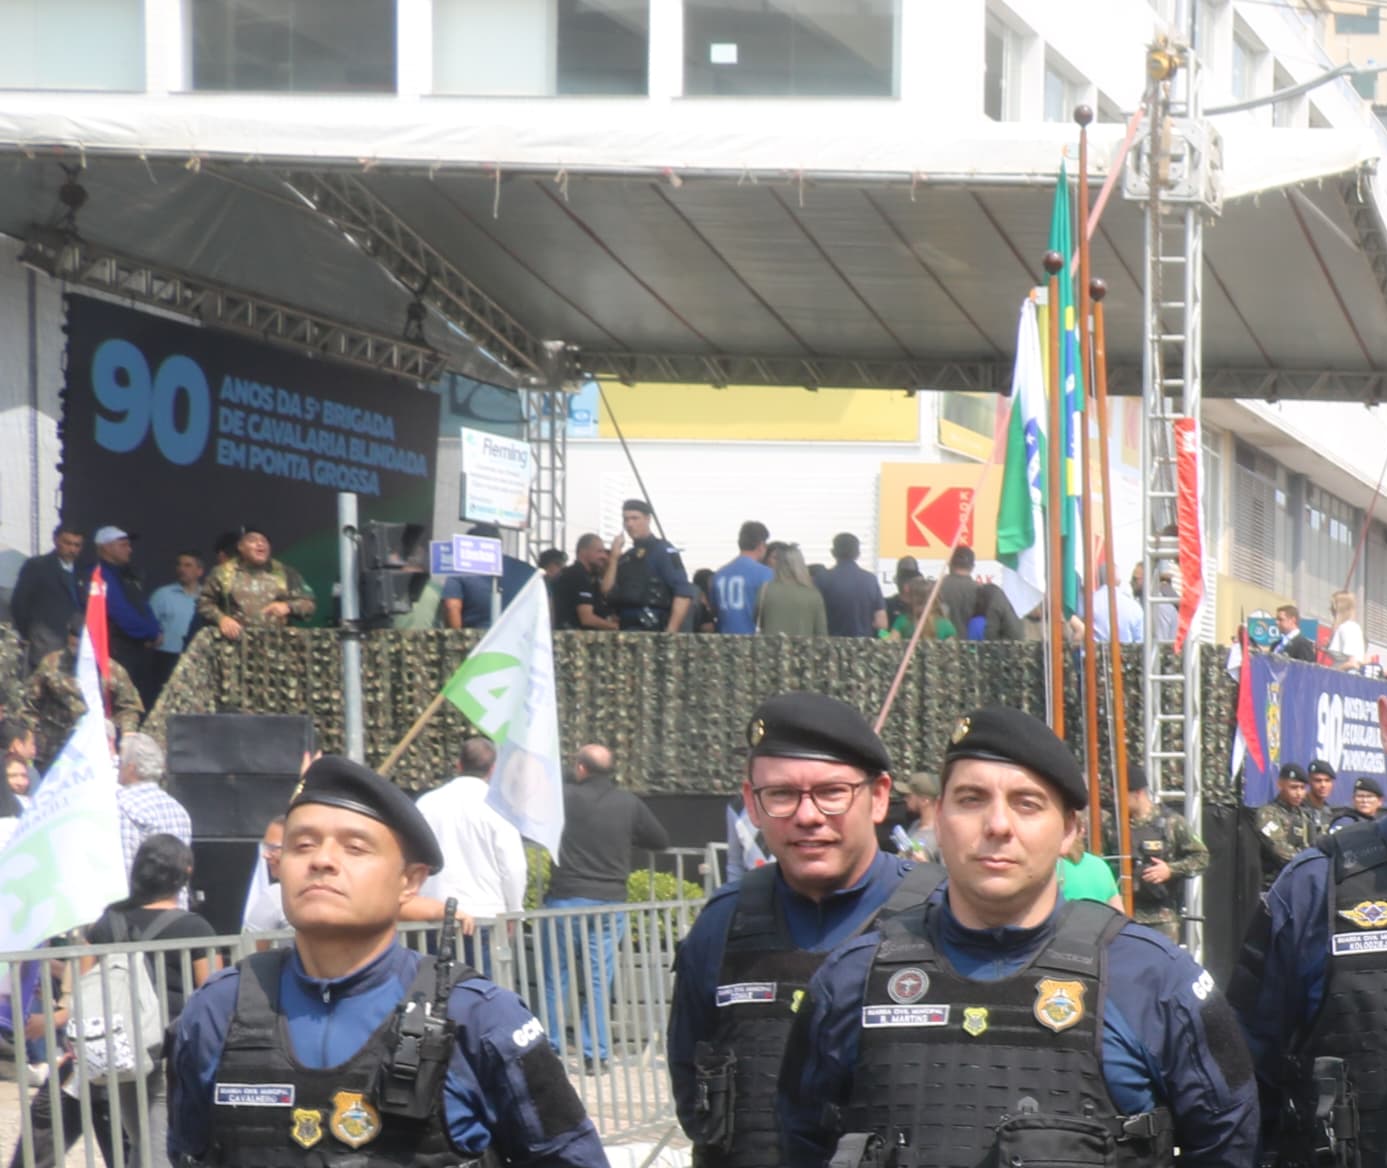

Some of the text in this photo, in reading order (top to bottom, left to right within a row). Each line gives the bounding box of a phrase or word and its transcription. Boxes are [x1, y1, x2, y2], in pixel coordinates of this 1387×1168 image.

[92, 338, 210, 466] 90
[219, 375, 275, 411] ANOS
[276, 389, 301, 416] DA
[321, 400, 395, 441] BRIGADA
[216, 438, 381, 496] EM PONTA GROSSA
[218, 406, 427, 477] DE CAVALARIA BLINDADA
[716, 576, 745, 610] 10
[1316, 692, 1343, 773] 90
